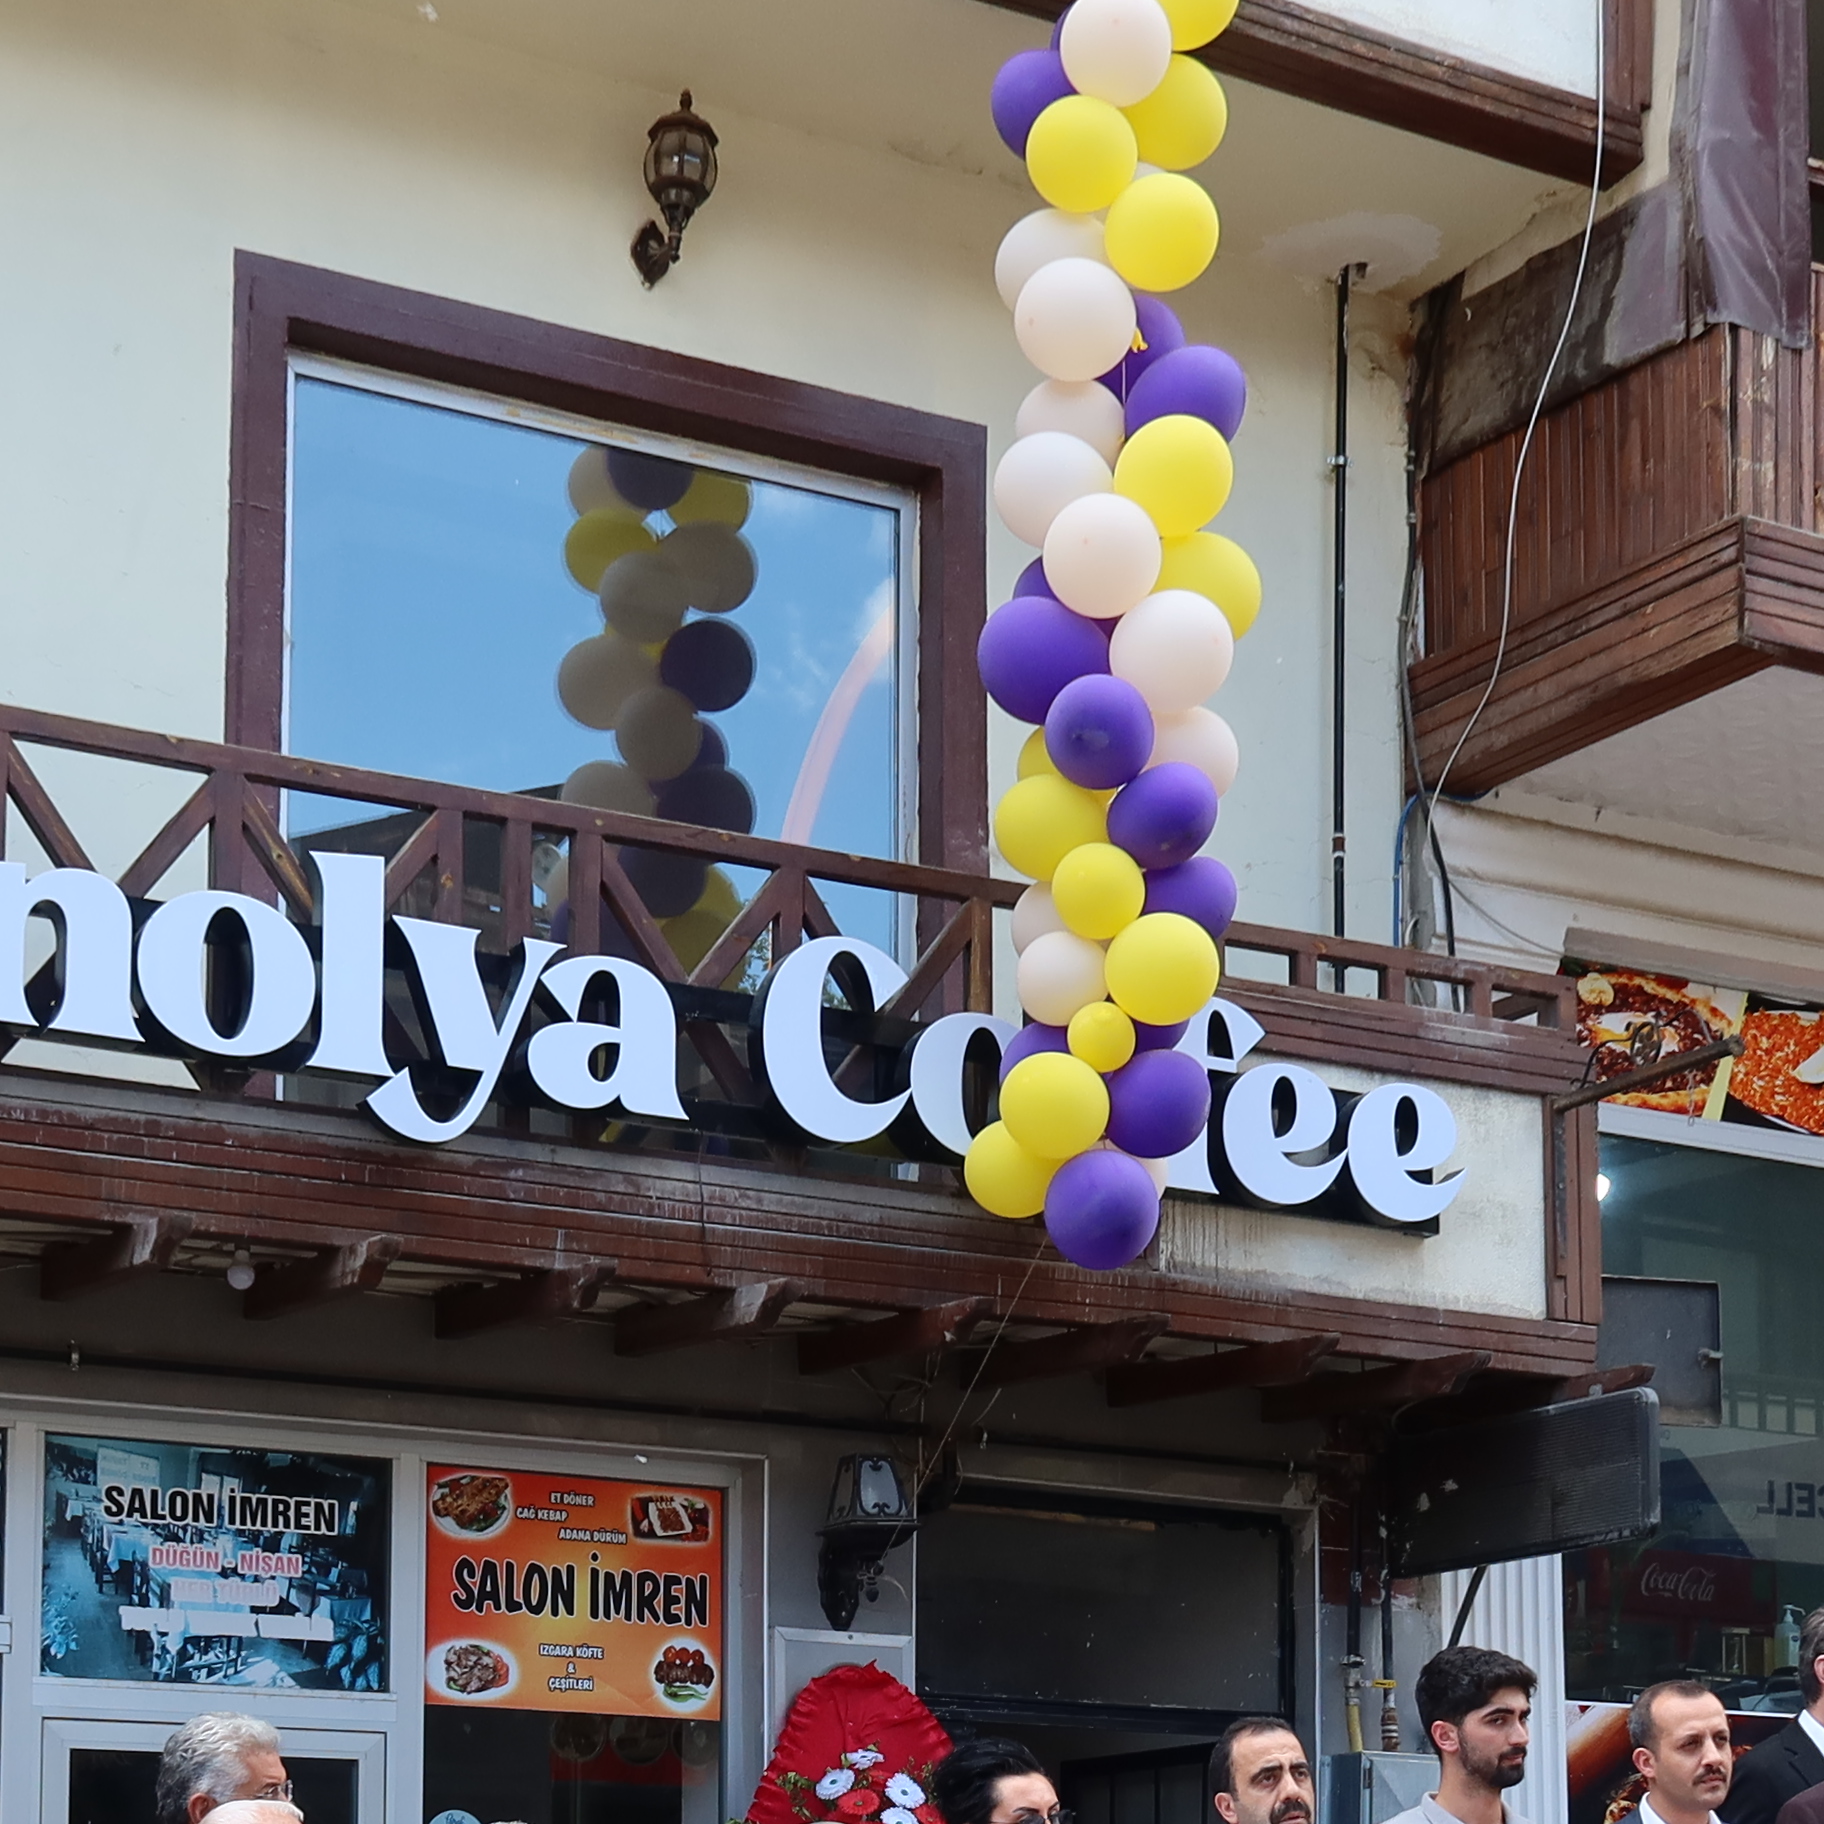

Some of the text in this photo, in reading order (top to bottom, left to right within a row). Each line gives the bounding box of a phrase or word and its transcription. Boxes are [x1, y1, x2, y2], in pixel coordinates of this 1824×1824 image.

[761, 932, 1465, 1228] Cofee
[550, 1492, 595, 1507] ET DÖNER
[103, 1483, 339, 1536] SALON İMREN
[537, 1509, 568, 1523] KEBAP
[558, 1528, 627, 1545] ADANA DÜRÜM
[149, 1543, 222, 1571] DÜĞÜN
[237, 1547, 303, 1578] NİŞAN
[451, 1550, 710, 1628] SALON İMREN
[576, 1644, 604, 1660] KÖFTE
[567, 1662, 576, 1674] &
[548, 1676, 594, 1692] ÇEŞİTLERİ
